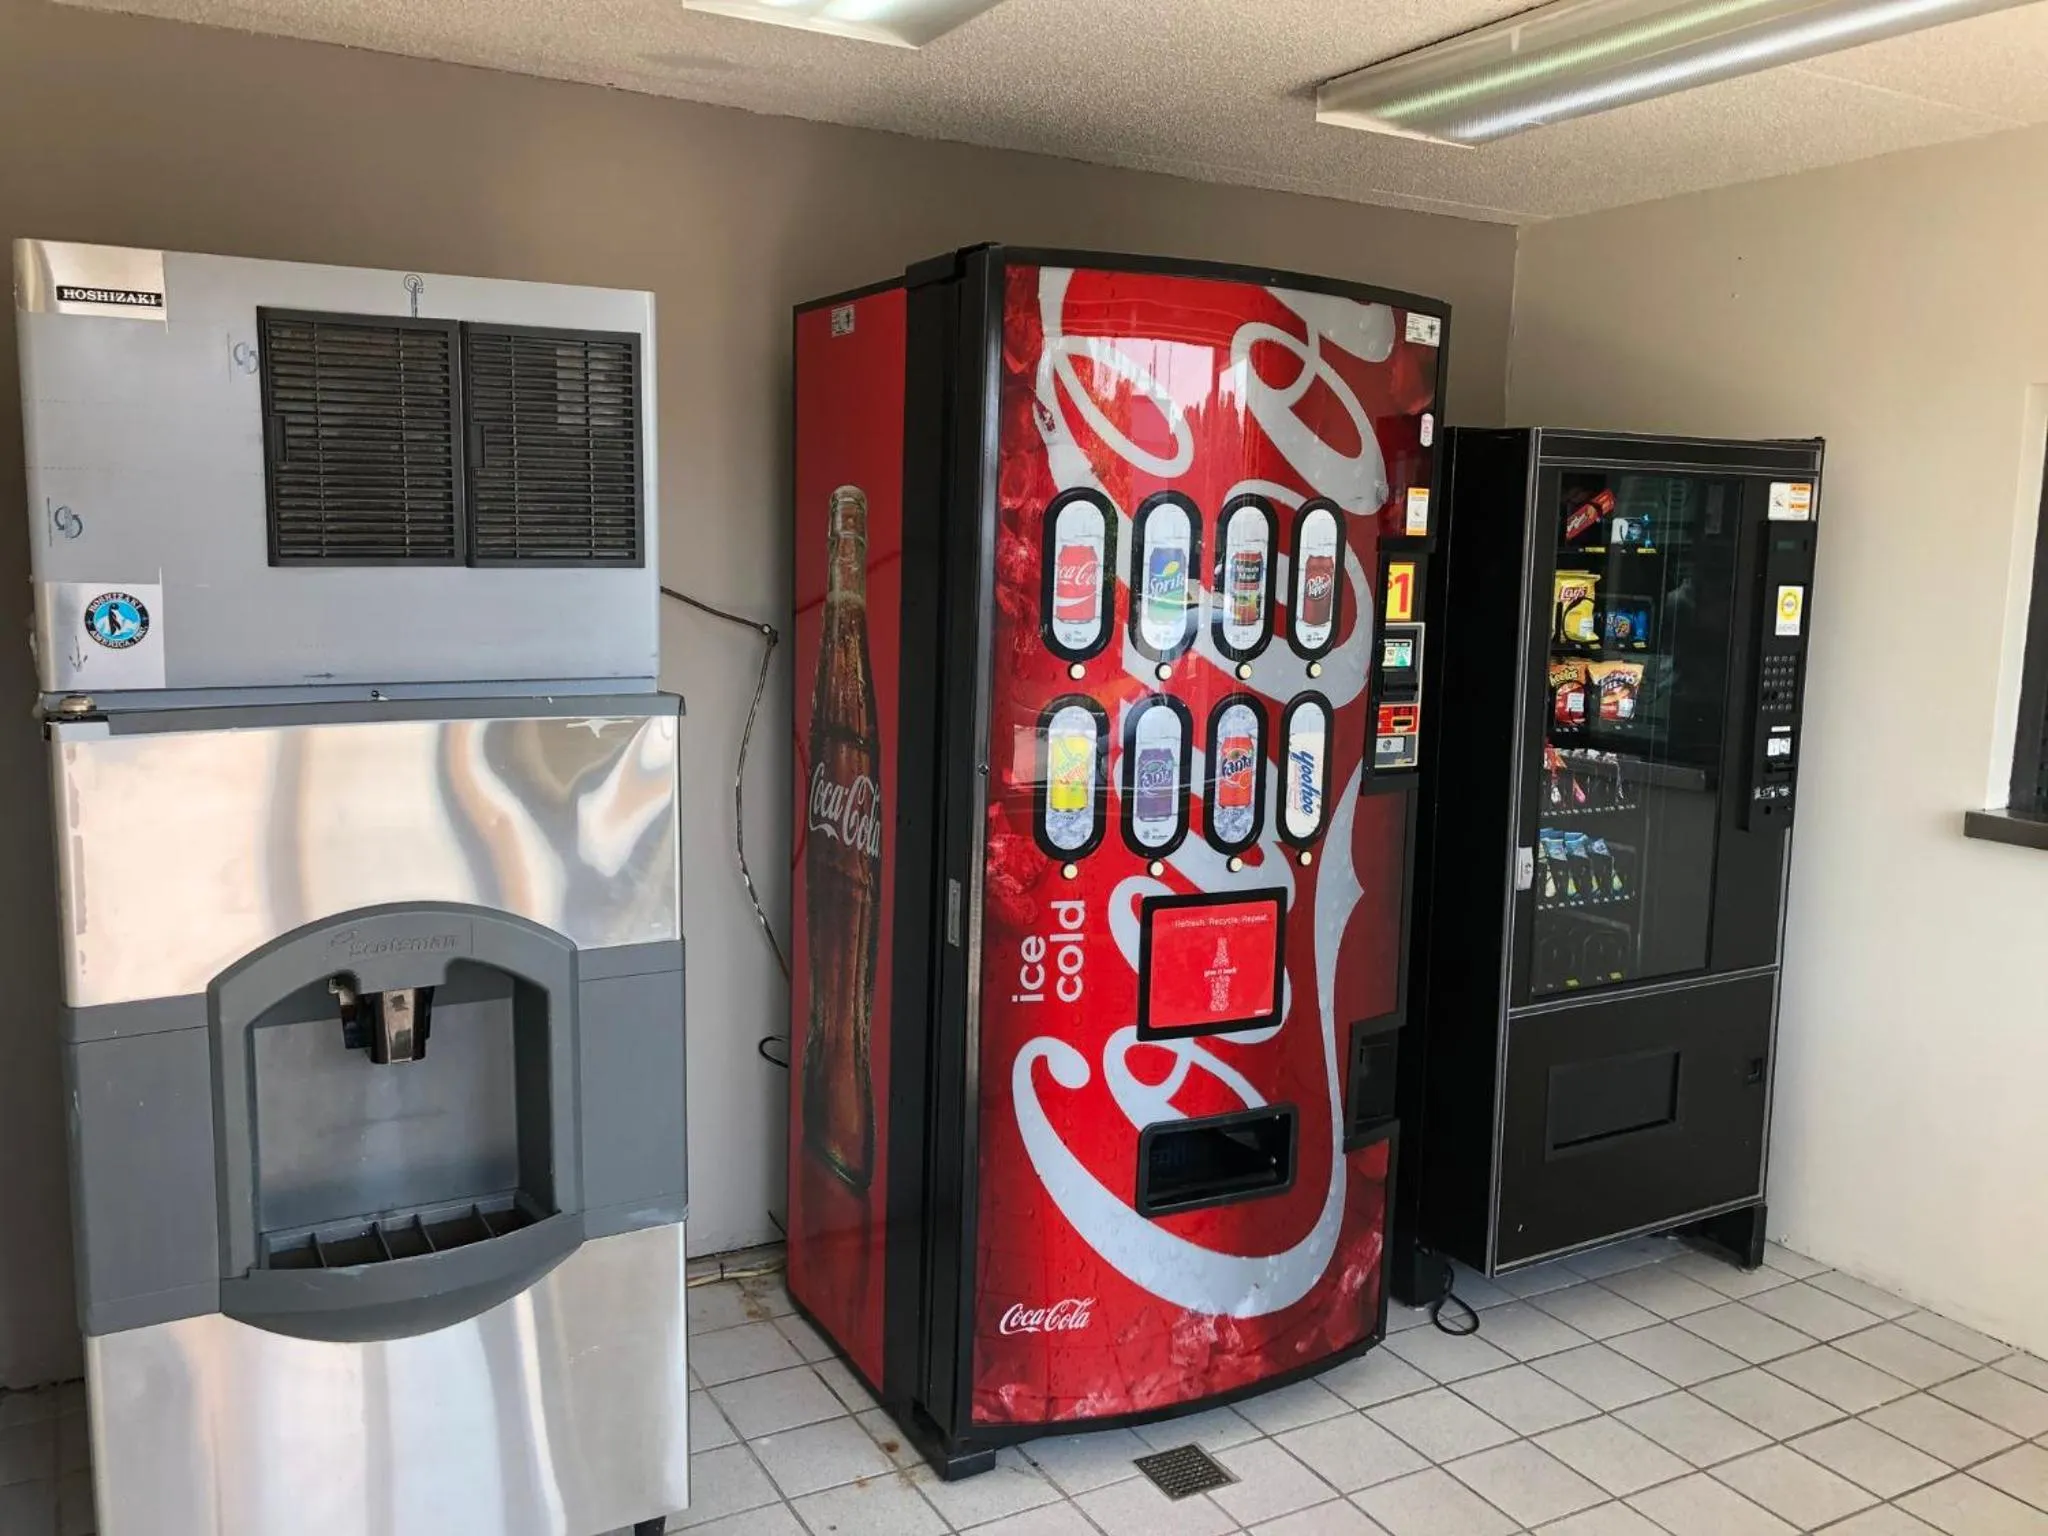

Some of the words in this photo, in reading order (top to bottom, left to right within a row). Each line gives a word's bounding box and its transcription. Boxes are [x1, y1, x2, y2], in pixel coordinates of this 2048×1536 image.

[63, 288, 157, 305] HOSHIZAKI
[1011, 935, 1046, 1002] ice
[1049, 900, 1085, 1002] cold
